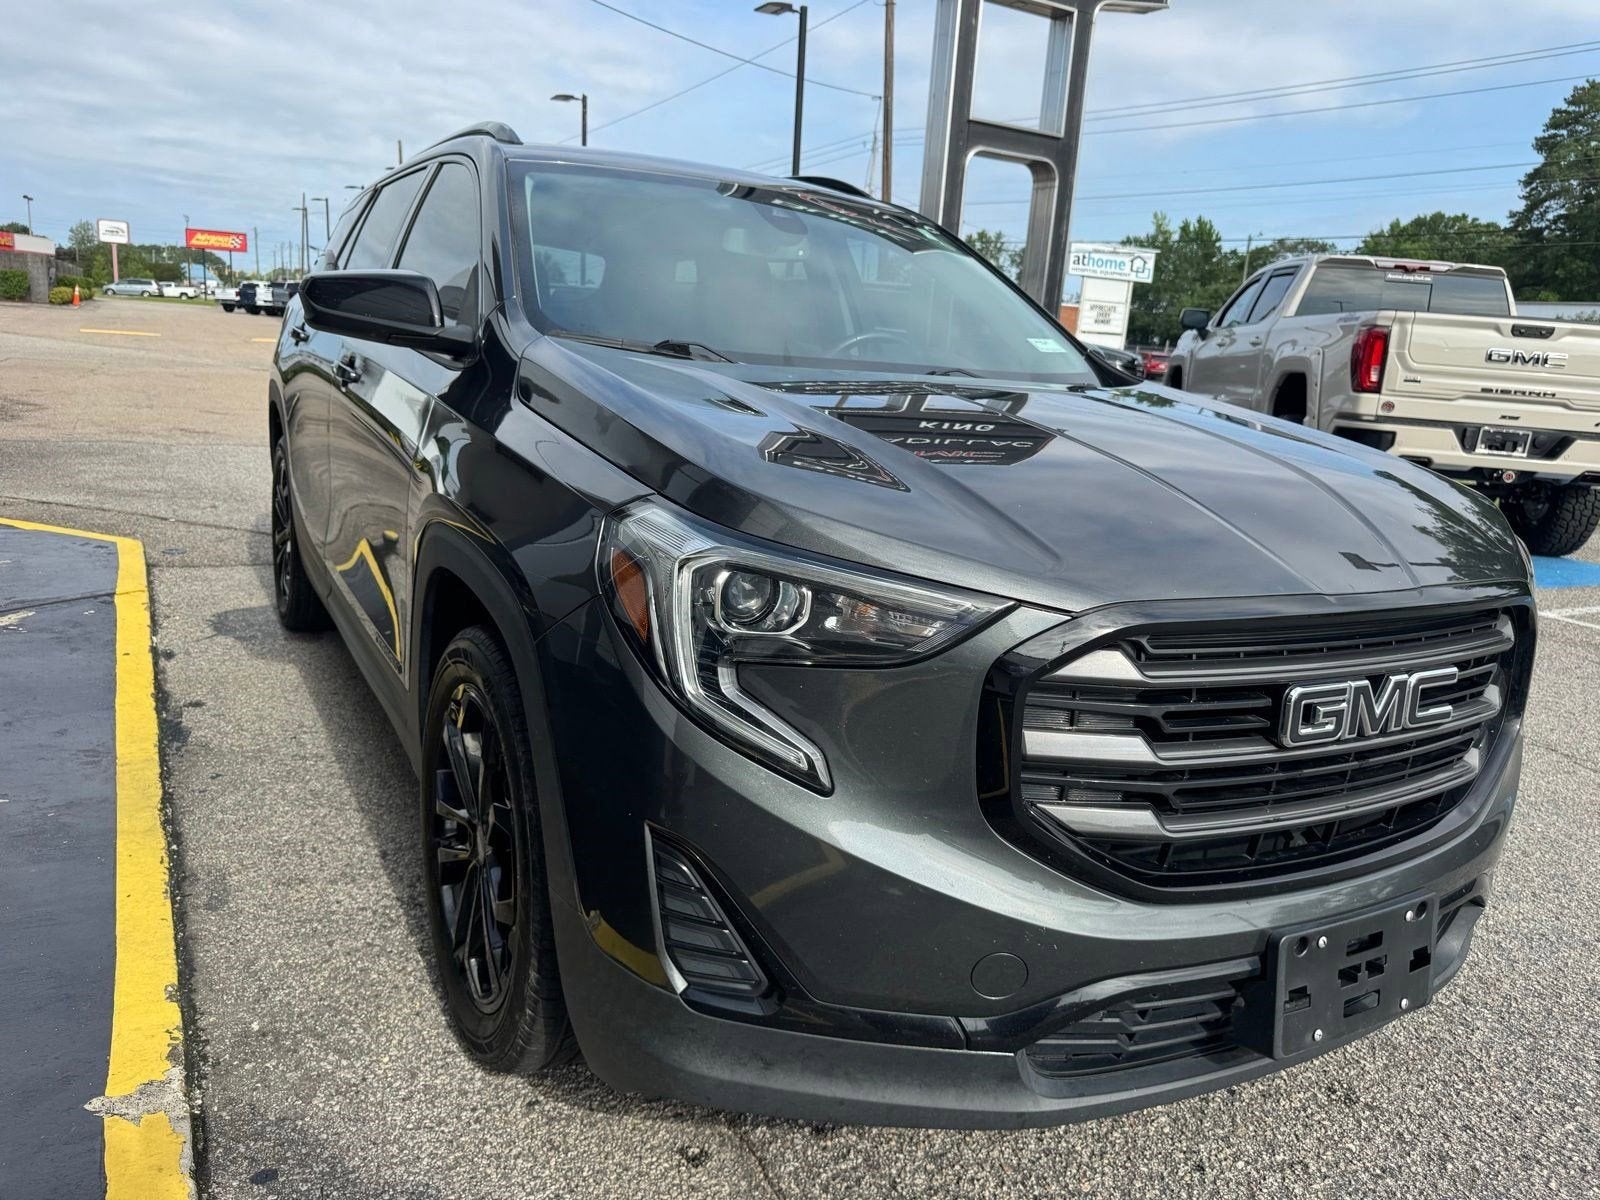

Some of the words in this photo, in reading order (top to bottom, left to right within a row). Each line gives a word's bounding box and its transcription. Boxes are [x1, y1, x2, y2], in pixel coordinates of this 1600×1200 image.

[1072, 251, 1126, 271] athome
[1485, 347, 1568, 369] GMC
[1481, 387, 1556, 397] SIERRA
[1280, 666, 1459, 748] GMC
